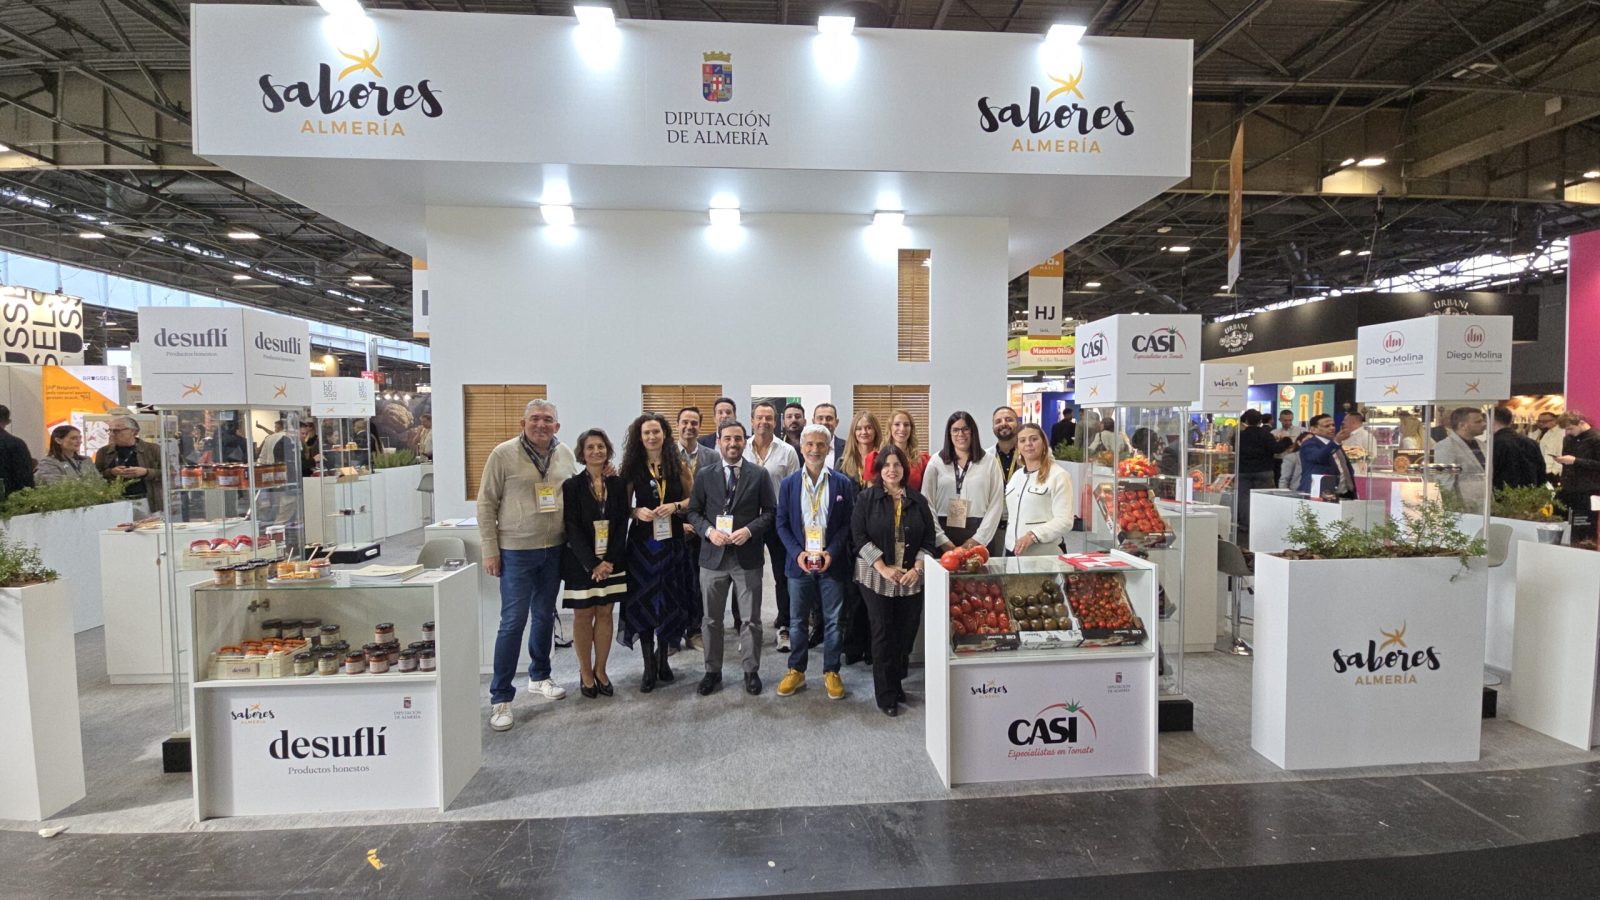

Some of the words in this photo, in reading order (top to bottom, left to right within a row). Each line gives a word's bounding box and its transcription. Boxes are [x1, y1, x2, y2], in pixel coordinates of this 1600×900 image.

[259, 63, 443, 118] sabores
[664, 110, 771, 127] DIPUTACIÓN
[977, 86, 1135, 137] sabores
[300, 119, 406, 136] ALMERÍA
[667, 129, 689, 144] DE
[694, 128, 769, 146] ALMERÍA
[1011, 137, 1102, 153] ALMERÍA
[1433, 298, 1469, 310] URBANI
[1035, 305, 1055, 320] HJ
[1224, 322, 1248, 335] URBANI
[154, 327, 228, 348] desuflí
[254, 331, 301, 355] desuflí
[1131, 334, 1176, 353] CASI
[1057, 346, 1072, 354] Oliva
[1081, 339, 1103, 359] CASI
[1446, 351, 1472, 361] Diego
[1474, 350, 1503, 359] Molina
[1366, 356, 1391, 366] Diego
[1393, 352, 1424, 363] Molina
[1332, 639, 1441, 674] sabores
[1354, 673, 1418, 686] ALMERÍA
[970, 683, 1008, 695] sabores
[231, 707, 276, 721] sabores
[1007, 716, 1078, 746] CASI
[269, 726, 388, 760] desuflí
[1007, 748, 1057, 761] Especialistas
[1067, 746, 1095, 755] Tomate
[288, 766, 332, 775] Productos
[332, 764, 370, 773] honestos
